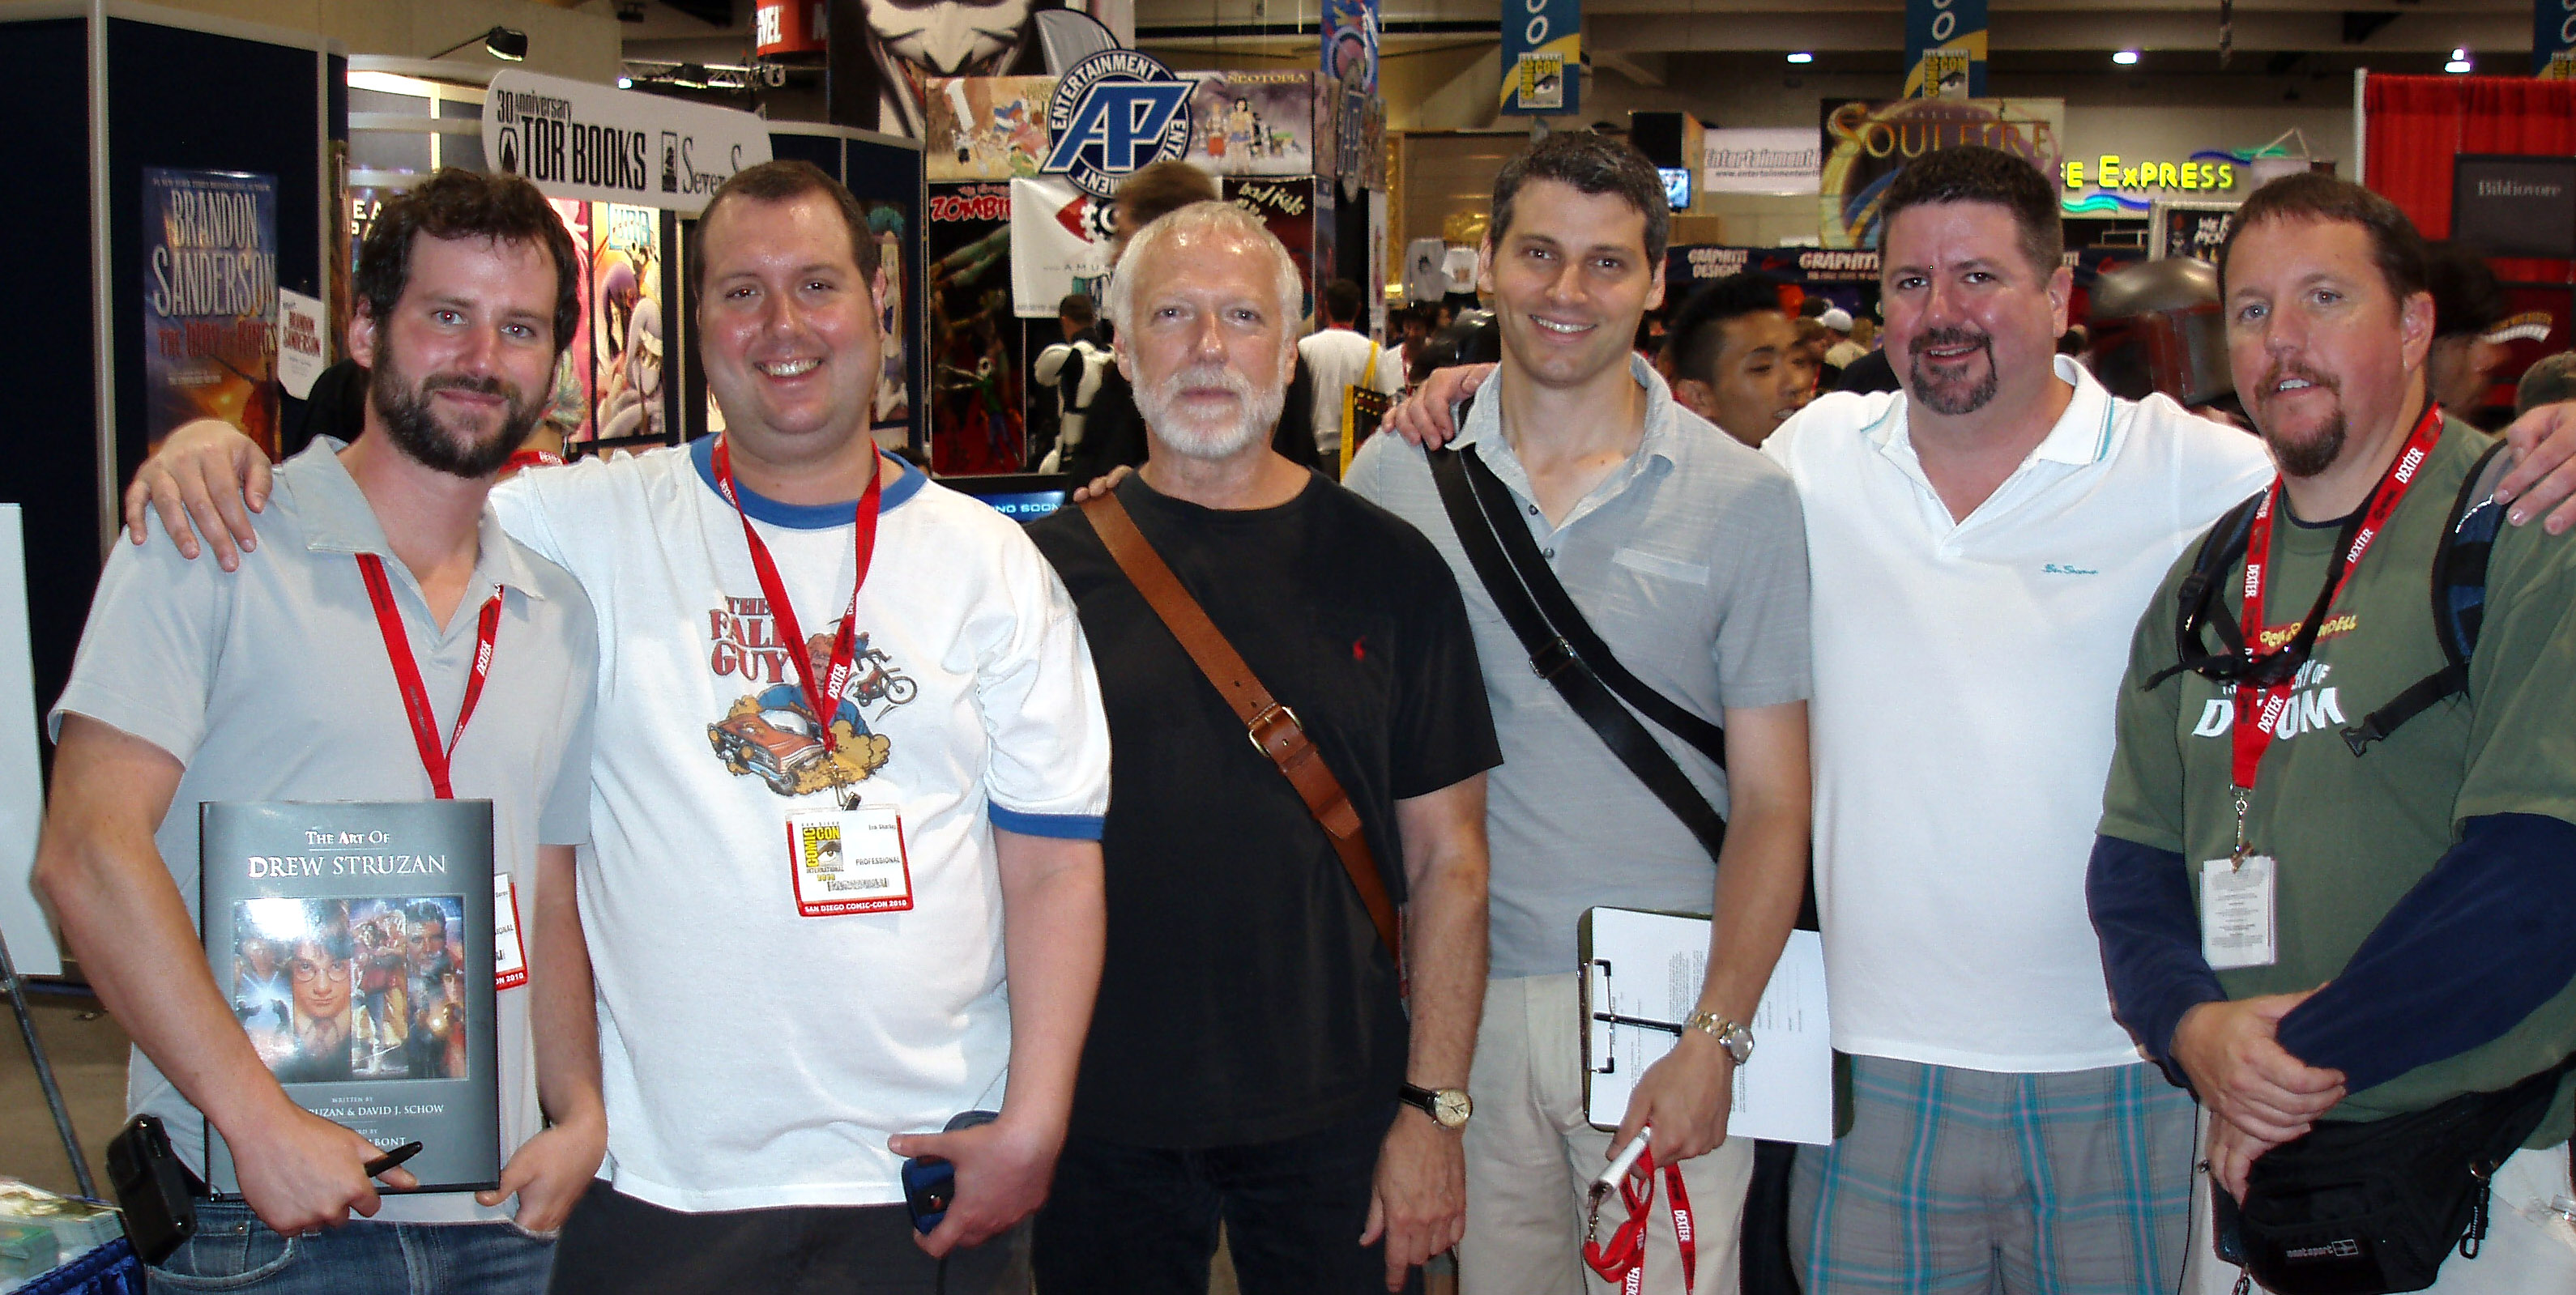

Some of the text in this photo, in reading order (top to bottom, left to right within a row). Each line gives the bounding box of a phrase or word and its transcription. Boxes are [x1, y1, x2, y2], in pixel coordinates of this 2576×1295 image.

[497, 89, 514, 124] 30
[1051, 54, 1160, 130] ENTERTAINMENT
[1041, 81, 1195, 173] AP
[521, 116, 646, 191] TOR BOOKS
[170, 190, 260, 249] BRANDON
[152, 244, 277, 317] SANDERSON
[2395, 446, 2425, 484] DEXTER
[2346, 528, 2374, 564] DEXTER
[2244, 564, 2261, 599] DEXTER
[476, 640, 492, 677] DEXTER
[710, 640, 791, 684] GUY
[2311, 663, 2331, 684] OF
[828, 663, 848, 700] DEXTER
[2257, 694, 2284, 735] DEXTER
[803, 827, 819, 867] COMIC
[817, 825, 841, 840] CON
[248, 854, 448, 878] DREW STRUZAN
[855, 857, 901, 866] PROFESSIONAL
[804, 899, 907, 913] SAN DIEGO COMIC-CON 2010
[505, 972, 524, 982] 2010
[347, 1107, 356, 1116] &
[358, 1106, 391, 1116] DAVID
[395, 1107, 402, 1116] J.
[403, 1104, 445, 1114] SCHOW
[1674, 1209, 1691, 1242] DEXTER
